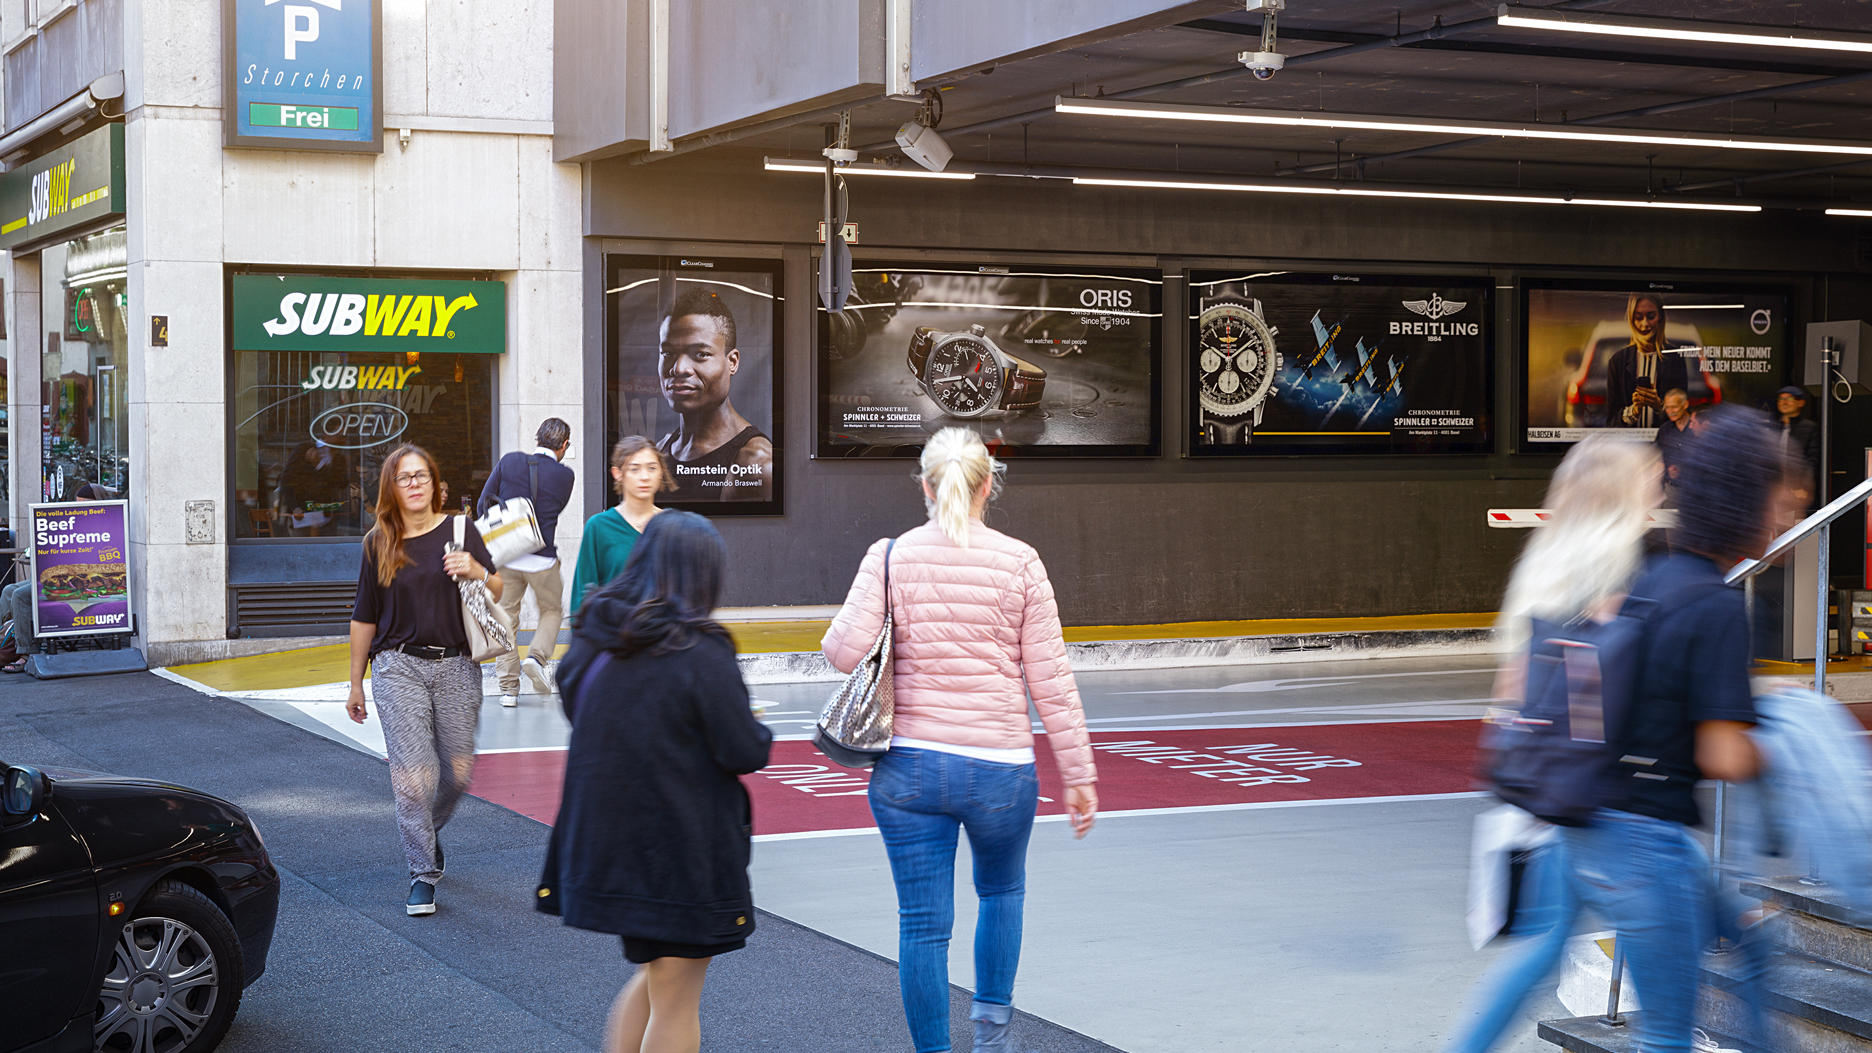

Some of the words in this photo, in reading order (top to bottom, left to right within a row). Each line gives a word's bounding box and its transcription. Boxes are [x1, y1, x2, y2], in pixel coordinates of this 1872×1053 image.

[284, 5, 320, 60] P
[244, 64, 362, 90] Storchen
[280, 105, 328, 128] Frei
[28, 158, 76, 225] SUBWAY
[1080, 288, 1132, 308] ORIS
[262, 292, 478, 338] SUBWAY
[1081, 317, 1099, 325] Since
[159, 326, 168, 342] 4
[1389, 322, 1478, 336] BREITLING
[1312, 325, 1342, 366] BREITLING
[1703, 346, 1720, 358] MEIN
[1722, 346, 1745, 358] NEUER
[1746, 347, 1771, 358] KOMMT
[1700, 360, 1714, 372] AUS
[1715, 360, 1730, 372] DEM
[302, 364, 422, 390] SUBWAY
[322, 413, 394, 436] OPEN
[676, 464, 727, 475] Ramstein
[730, 464, 762, 477] Optik
[36, 516, 75, 532] Beef
[37, 532, 111, 548] Supreme
[99, 550, 120, 562] BBQ
[72, 613, 124, 626] SUBWAY
[1089, 740, 1311, 787] METER
[1205, 743, 1362, 771] NUR
